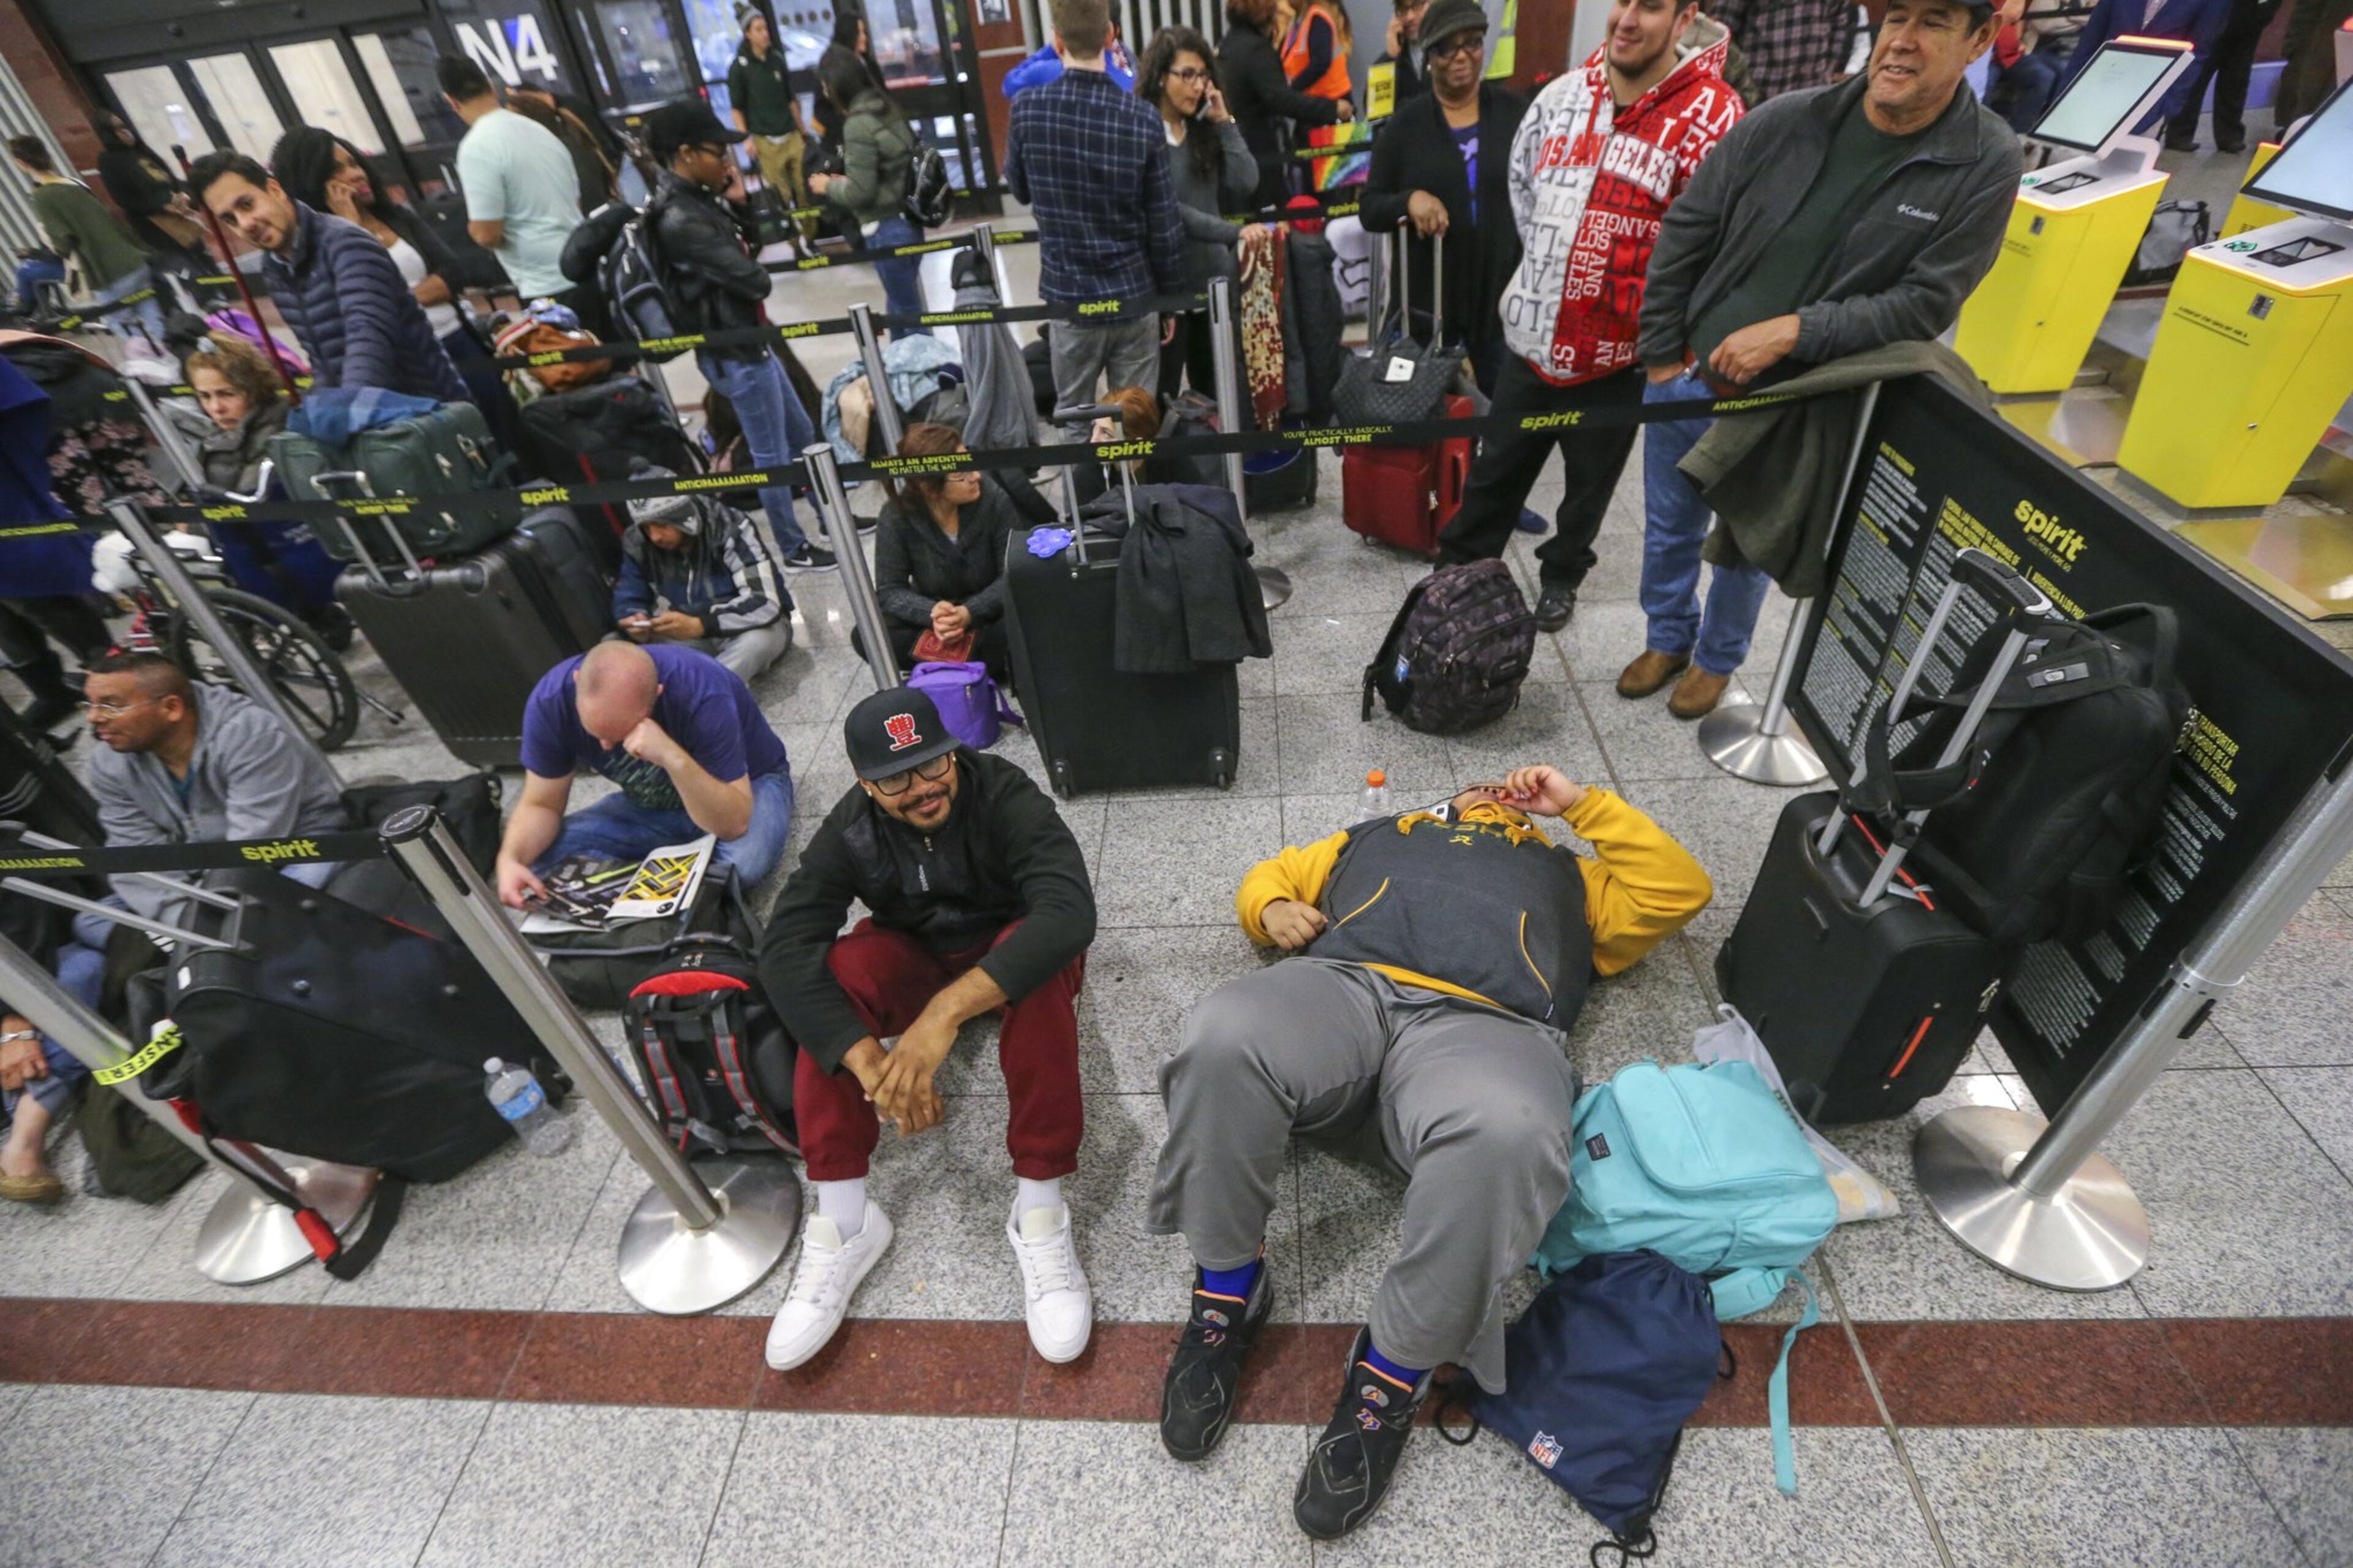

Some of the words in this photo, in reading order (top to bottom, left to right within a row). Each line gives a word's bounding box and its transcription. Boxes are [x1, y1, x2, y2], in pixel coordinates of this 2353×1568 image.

[455, 13, 559, 86] N4
[798, 256, 830, 270] spirit
[1078, 300, 1121, 316] spirit
[781, 322, 820, 338] spirit
[1520, 411, 1583, 430] spirit
[1303, 436, 1340, 446] ALMOST
[1344, 434, 1372, 443] THERE
[1096, 441, 1154, 458] spirit
[871, 458, 904, 468] ALWAYS
[922, 454, 973, 464] ADVENTURE
[900, 464, 926, 474] MATTER
[520, 488, 570, 506] spirit
[2014, 499, 2087, 562] spirit
[241, 839, 320, 863] spirit
[1356, 1408, 1382, 1431] 23
[1533, 1443, 1554, 1466] NFL
